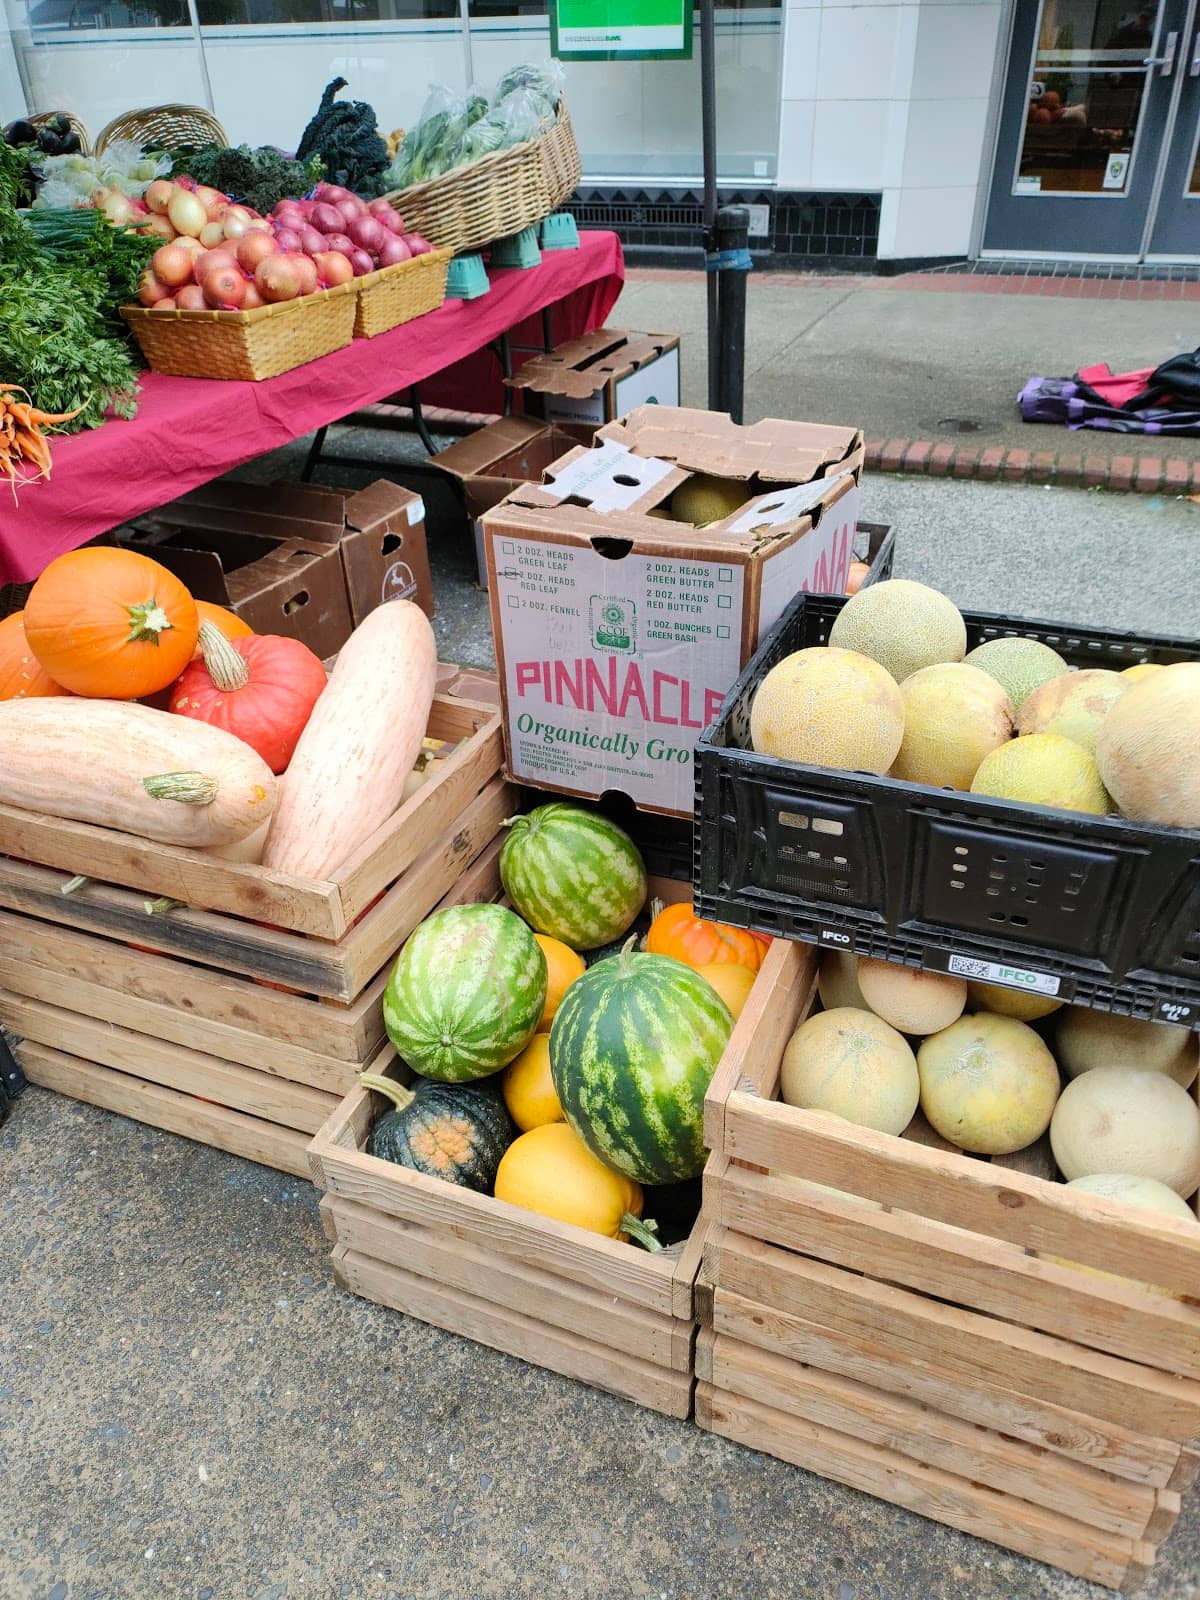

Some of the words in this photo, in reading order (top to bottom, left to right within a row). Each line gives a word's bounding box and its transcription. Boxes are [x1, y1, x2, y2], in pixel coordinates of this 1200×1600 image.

[547, 550, 574, 561] HEADS
[519, 557, 545, 568] GREEN
[548, 561, 568, 571] LEAF
[646, 563, 652, 571] 2
[680, 566, 710, 577] HEADS
[521, 581, 536, 591] RED
[540, 584, 558, 594] LEAF
[549, 576, 575, 586] HEADS
[647, 574, 676, 585] GREEN
[680, 579, 714, 589] BUTTER
[646, 589, 652, 597] 2
[680, 593, 709, 603] HEADS
[551, 604, 581, 616] FENNEL
[647, 600, 664, 609] RED
[667, 602, 702, 613] BUTTER
[674, 622, 712, 634] BUNCHES
[647, 630, 673, 639] GREEN
[675, 633, 698, 643] BASIL
[517, 713, 640, 761] Organically
[646, 738, 691, 764] Gro
[520, 757, 549, 770] PRODUCE
[822, 930, 850, 944] IFCO
[998, 967, 1037, 984] IFCO
